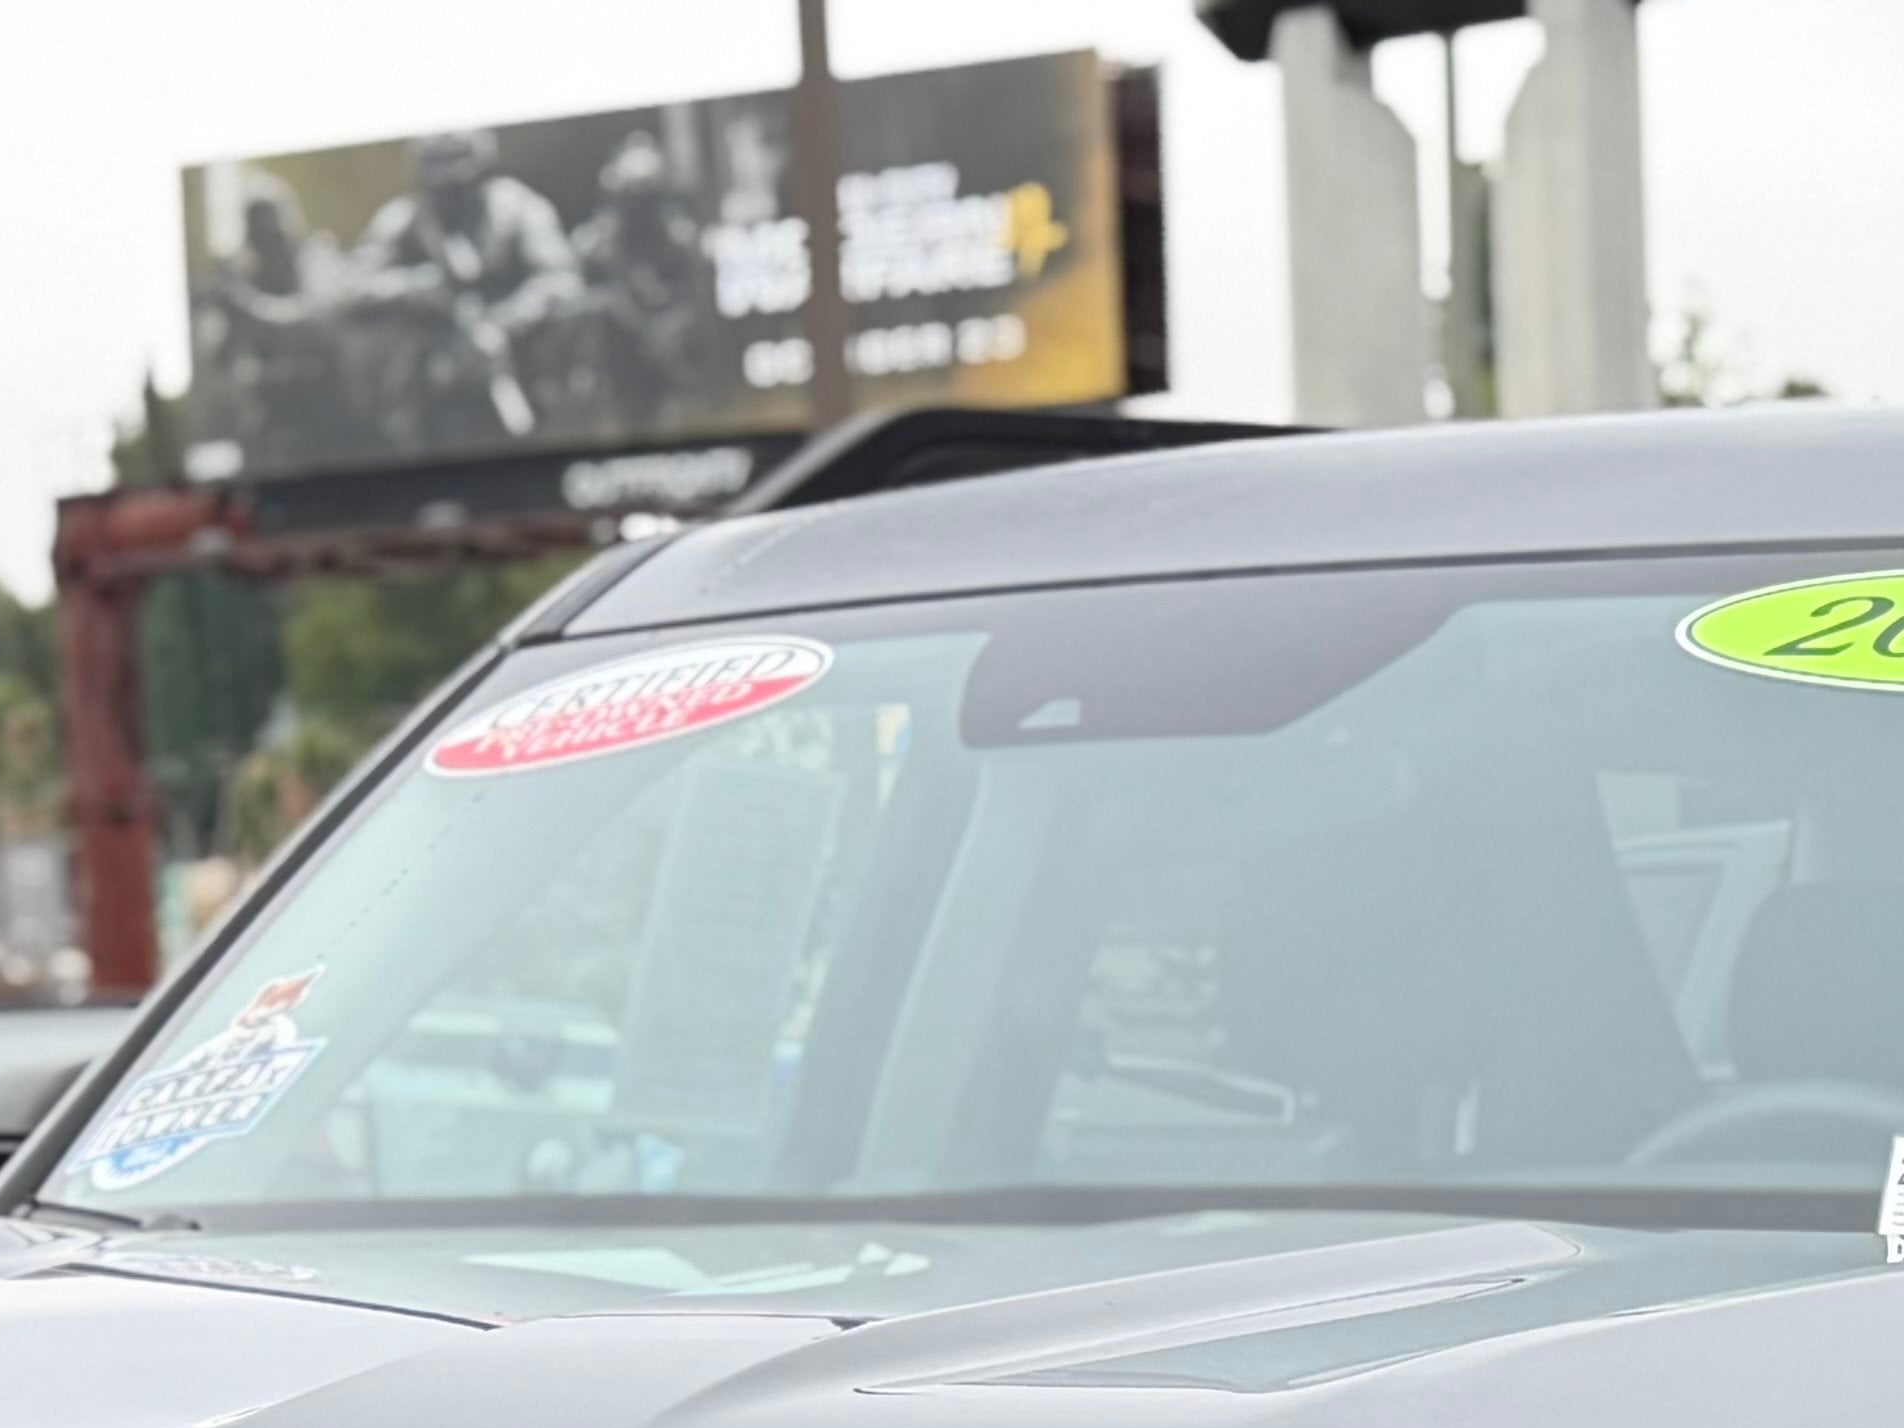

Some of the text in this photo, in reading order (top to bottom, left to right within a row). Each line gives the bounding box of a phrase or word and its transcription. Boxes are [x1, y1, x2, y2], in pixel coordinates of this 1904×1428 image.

[491, 650, 796, 728] CERTIFIED
[502, 711, 690, 760] VEHICLE
[124, 1062, 292, 1114] CARFAX
[118, 1094, 264, 1146] OWNER
